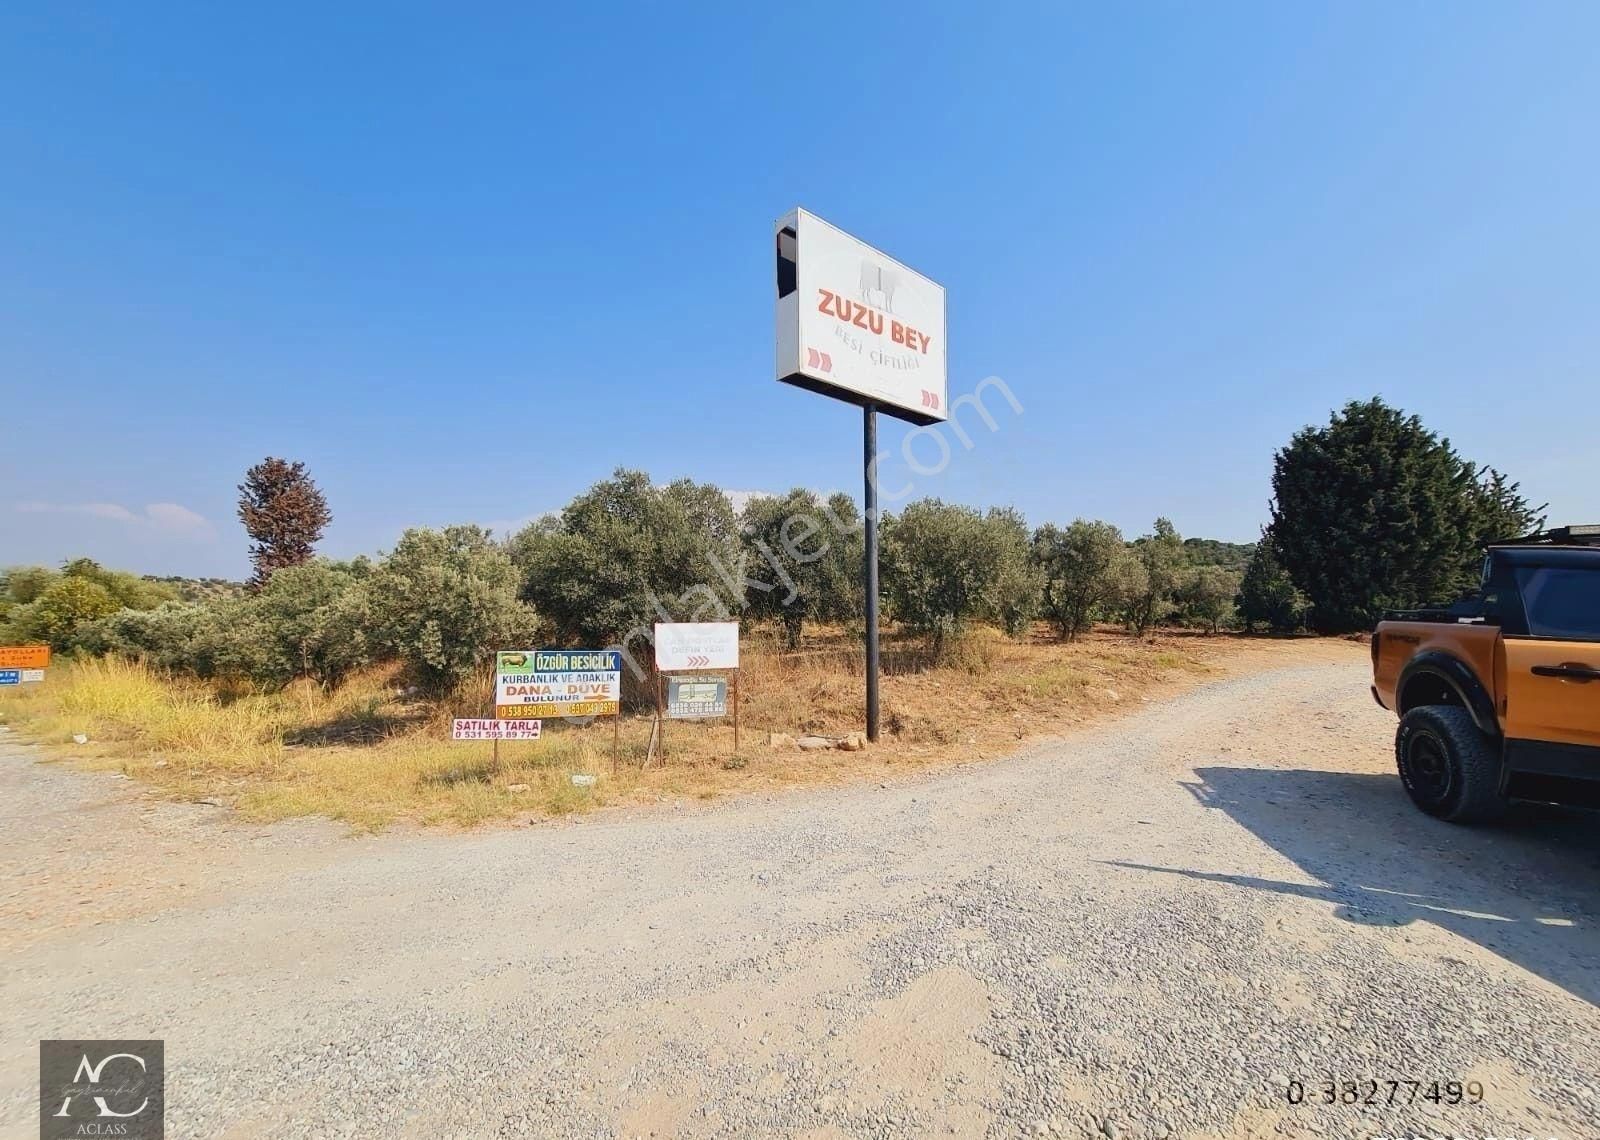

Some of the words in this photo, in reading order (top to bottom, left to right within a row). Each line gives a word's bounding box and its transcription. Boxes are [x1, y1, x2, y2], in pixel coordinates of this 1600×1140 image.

[818, 288, 883, 335] ZUZU
[891, 319, 931, 355] BEY
[536, 653, 569, 671] ÖZGÜR
[502, 674, 558, 685] KURBANLIK
[561, 674, 574, 683] VE
[576, 672, 616, 683] ADAKLIK
[506, 685, 552, 697] DANA
[456, 721, 500, 731] SATILIK
[504, 721, 539, 731] TARLA
